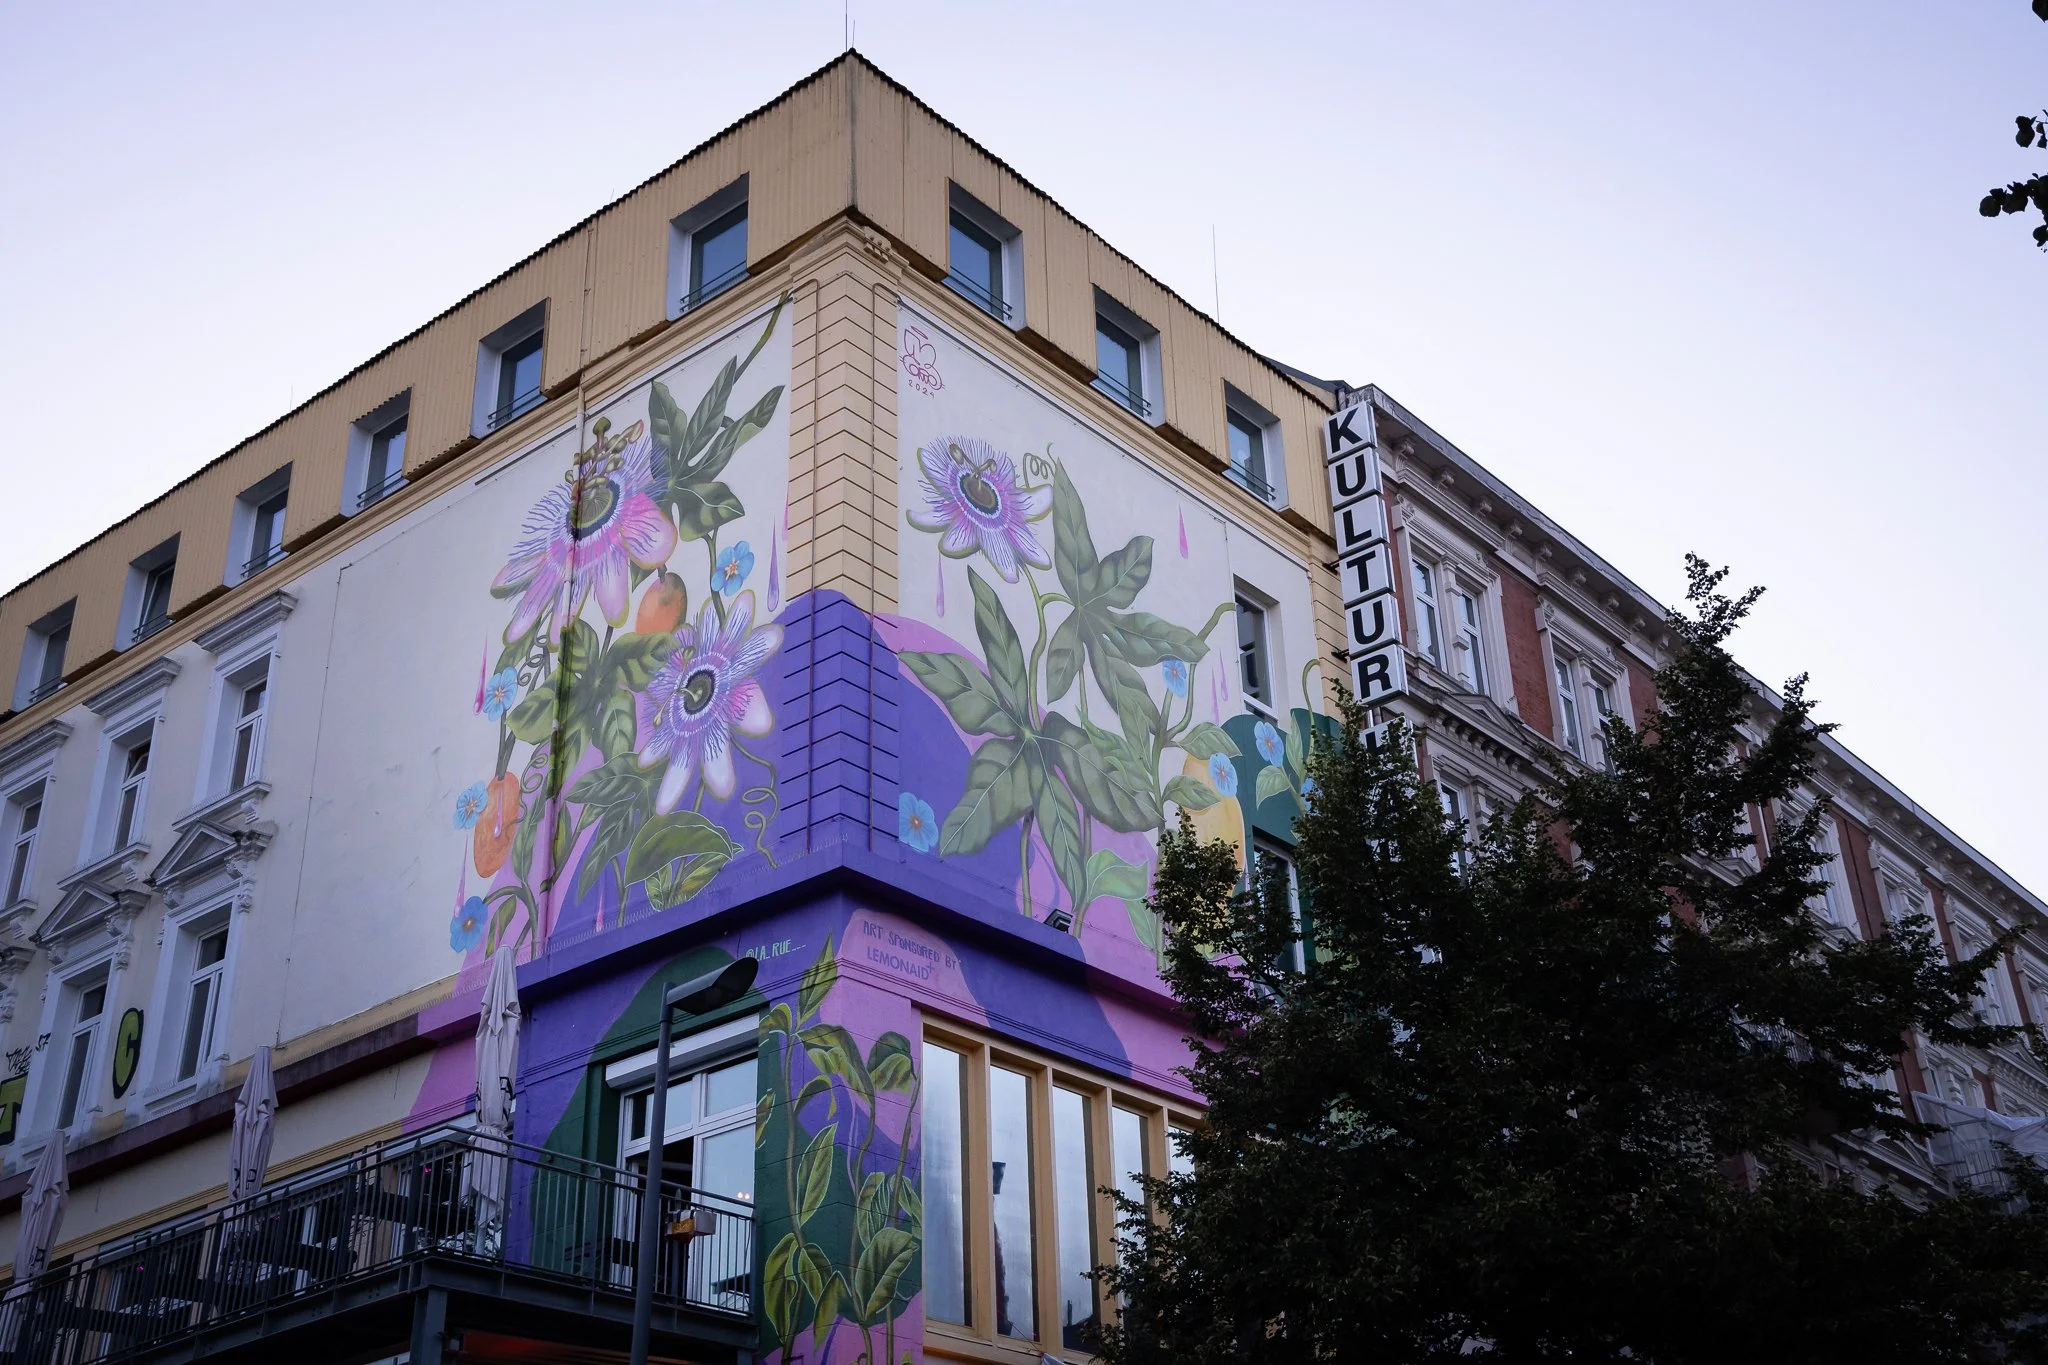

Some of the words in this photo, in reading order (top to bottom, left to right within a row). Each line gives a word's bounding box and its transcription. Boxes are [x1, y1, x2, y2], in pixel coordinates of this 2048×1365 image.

[1328, 407, 1393, 702] KULTUR
[863, 920, 883, 939] ART
[888, 931, 940, 963] SPONSORED
[945, 955, 957, 970] BY
